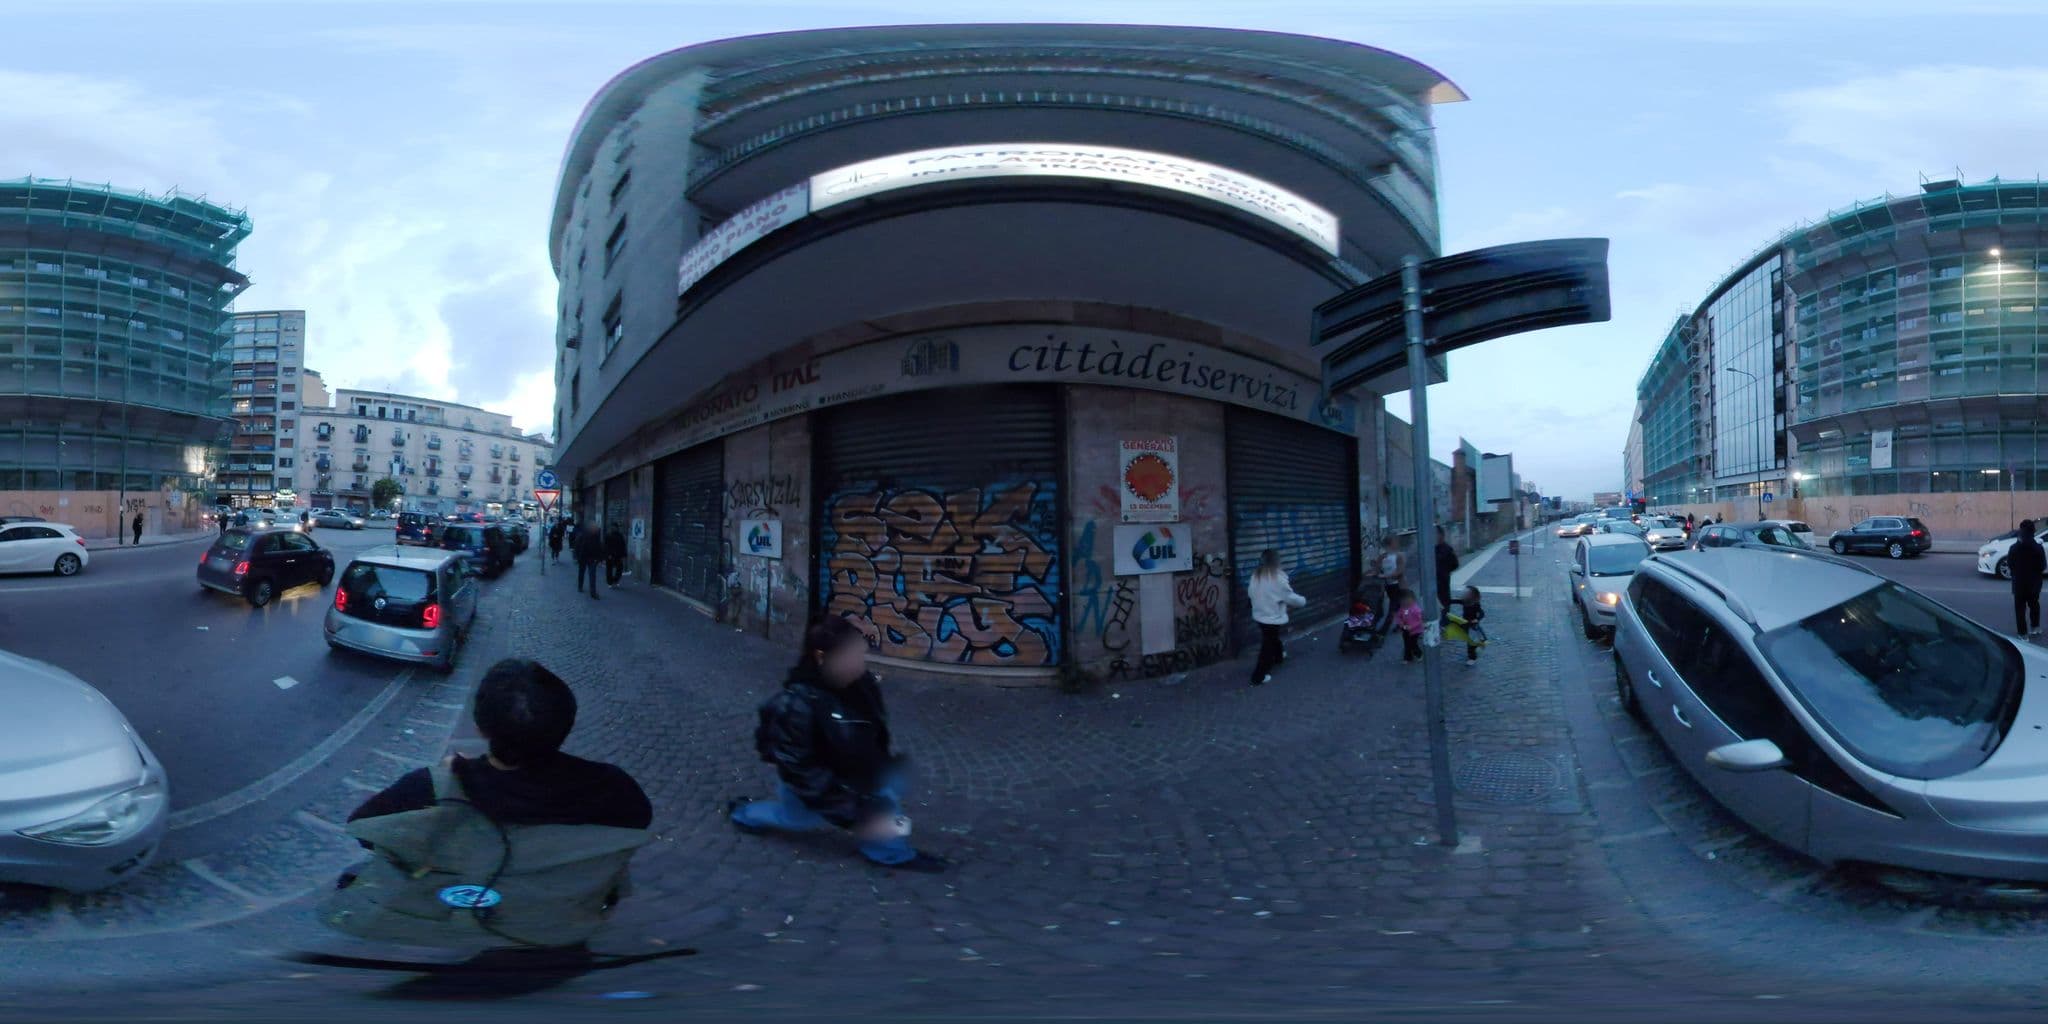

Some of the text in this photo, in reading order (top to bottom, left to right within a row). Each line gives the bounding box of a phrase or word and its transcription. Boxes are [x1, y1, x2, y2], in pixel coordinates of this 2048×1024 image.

[1007, 334, 1300, 412] cittàdeiservizi
[756, 535, 772, 548] UIL
[1149, 545, 1177, 560] UIL
